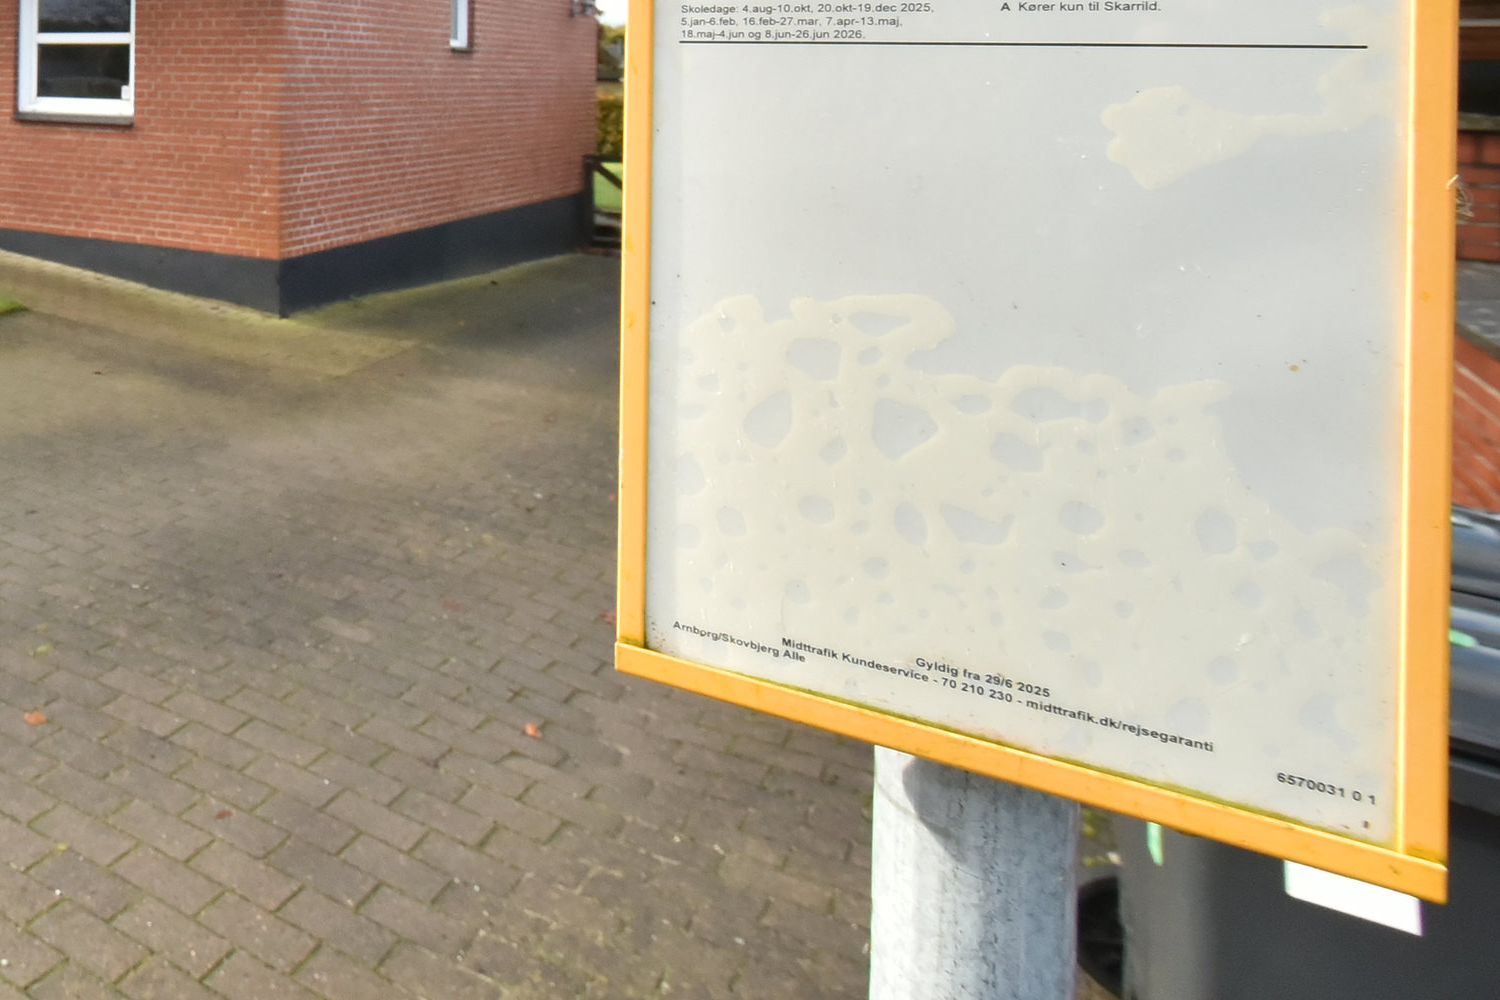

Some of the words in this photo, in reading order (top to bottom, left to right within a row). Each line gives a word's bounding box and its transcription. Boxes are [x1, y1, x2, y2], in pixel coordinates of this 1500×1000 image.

[681, 4, 739, 15] Skoledage:
[817, 3, 897, 13] 20.okt-19.dec
[1000, 2, 1011, 12] A
[1018, 2, 1056, 12] Kører
[1060, 2, 1084, 12] kun
[1088, 1, 1100, 12] til
[1104, 1, 1161, 13] Skarrild.
[748, 32, 761, 40] og
[765, 29, 830, 41] 8.jun-26.jun
[673, 621, 779, 657] Arnborg/Skovbjerg
[783, 650, 806, 662] Alle
[915, 657, 959, 678] Gyldig
[963, 669, 982, 681] fra
[985, 674, 1013, 689] 29/6
[1017, 682, 1051, 699] 2025
[782, 637, 838, 660] Midttrafik
[842, 653, 929, 683] Kundeservice
[942, 678, 957, 689] 70
[961, 683, 985, 697] 210
[989, 690, 1013, 703] 230
[1026, 698, 1215, 753] midttrafik.dk/rejsegaranti
[1277, 772, 1345, 797] 6570031
[1352, 790, 1362, 801] 0
[1369, 794, 1376, 805] 1
